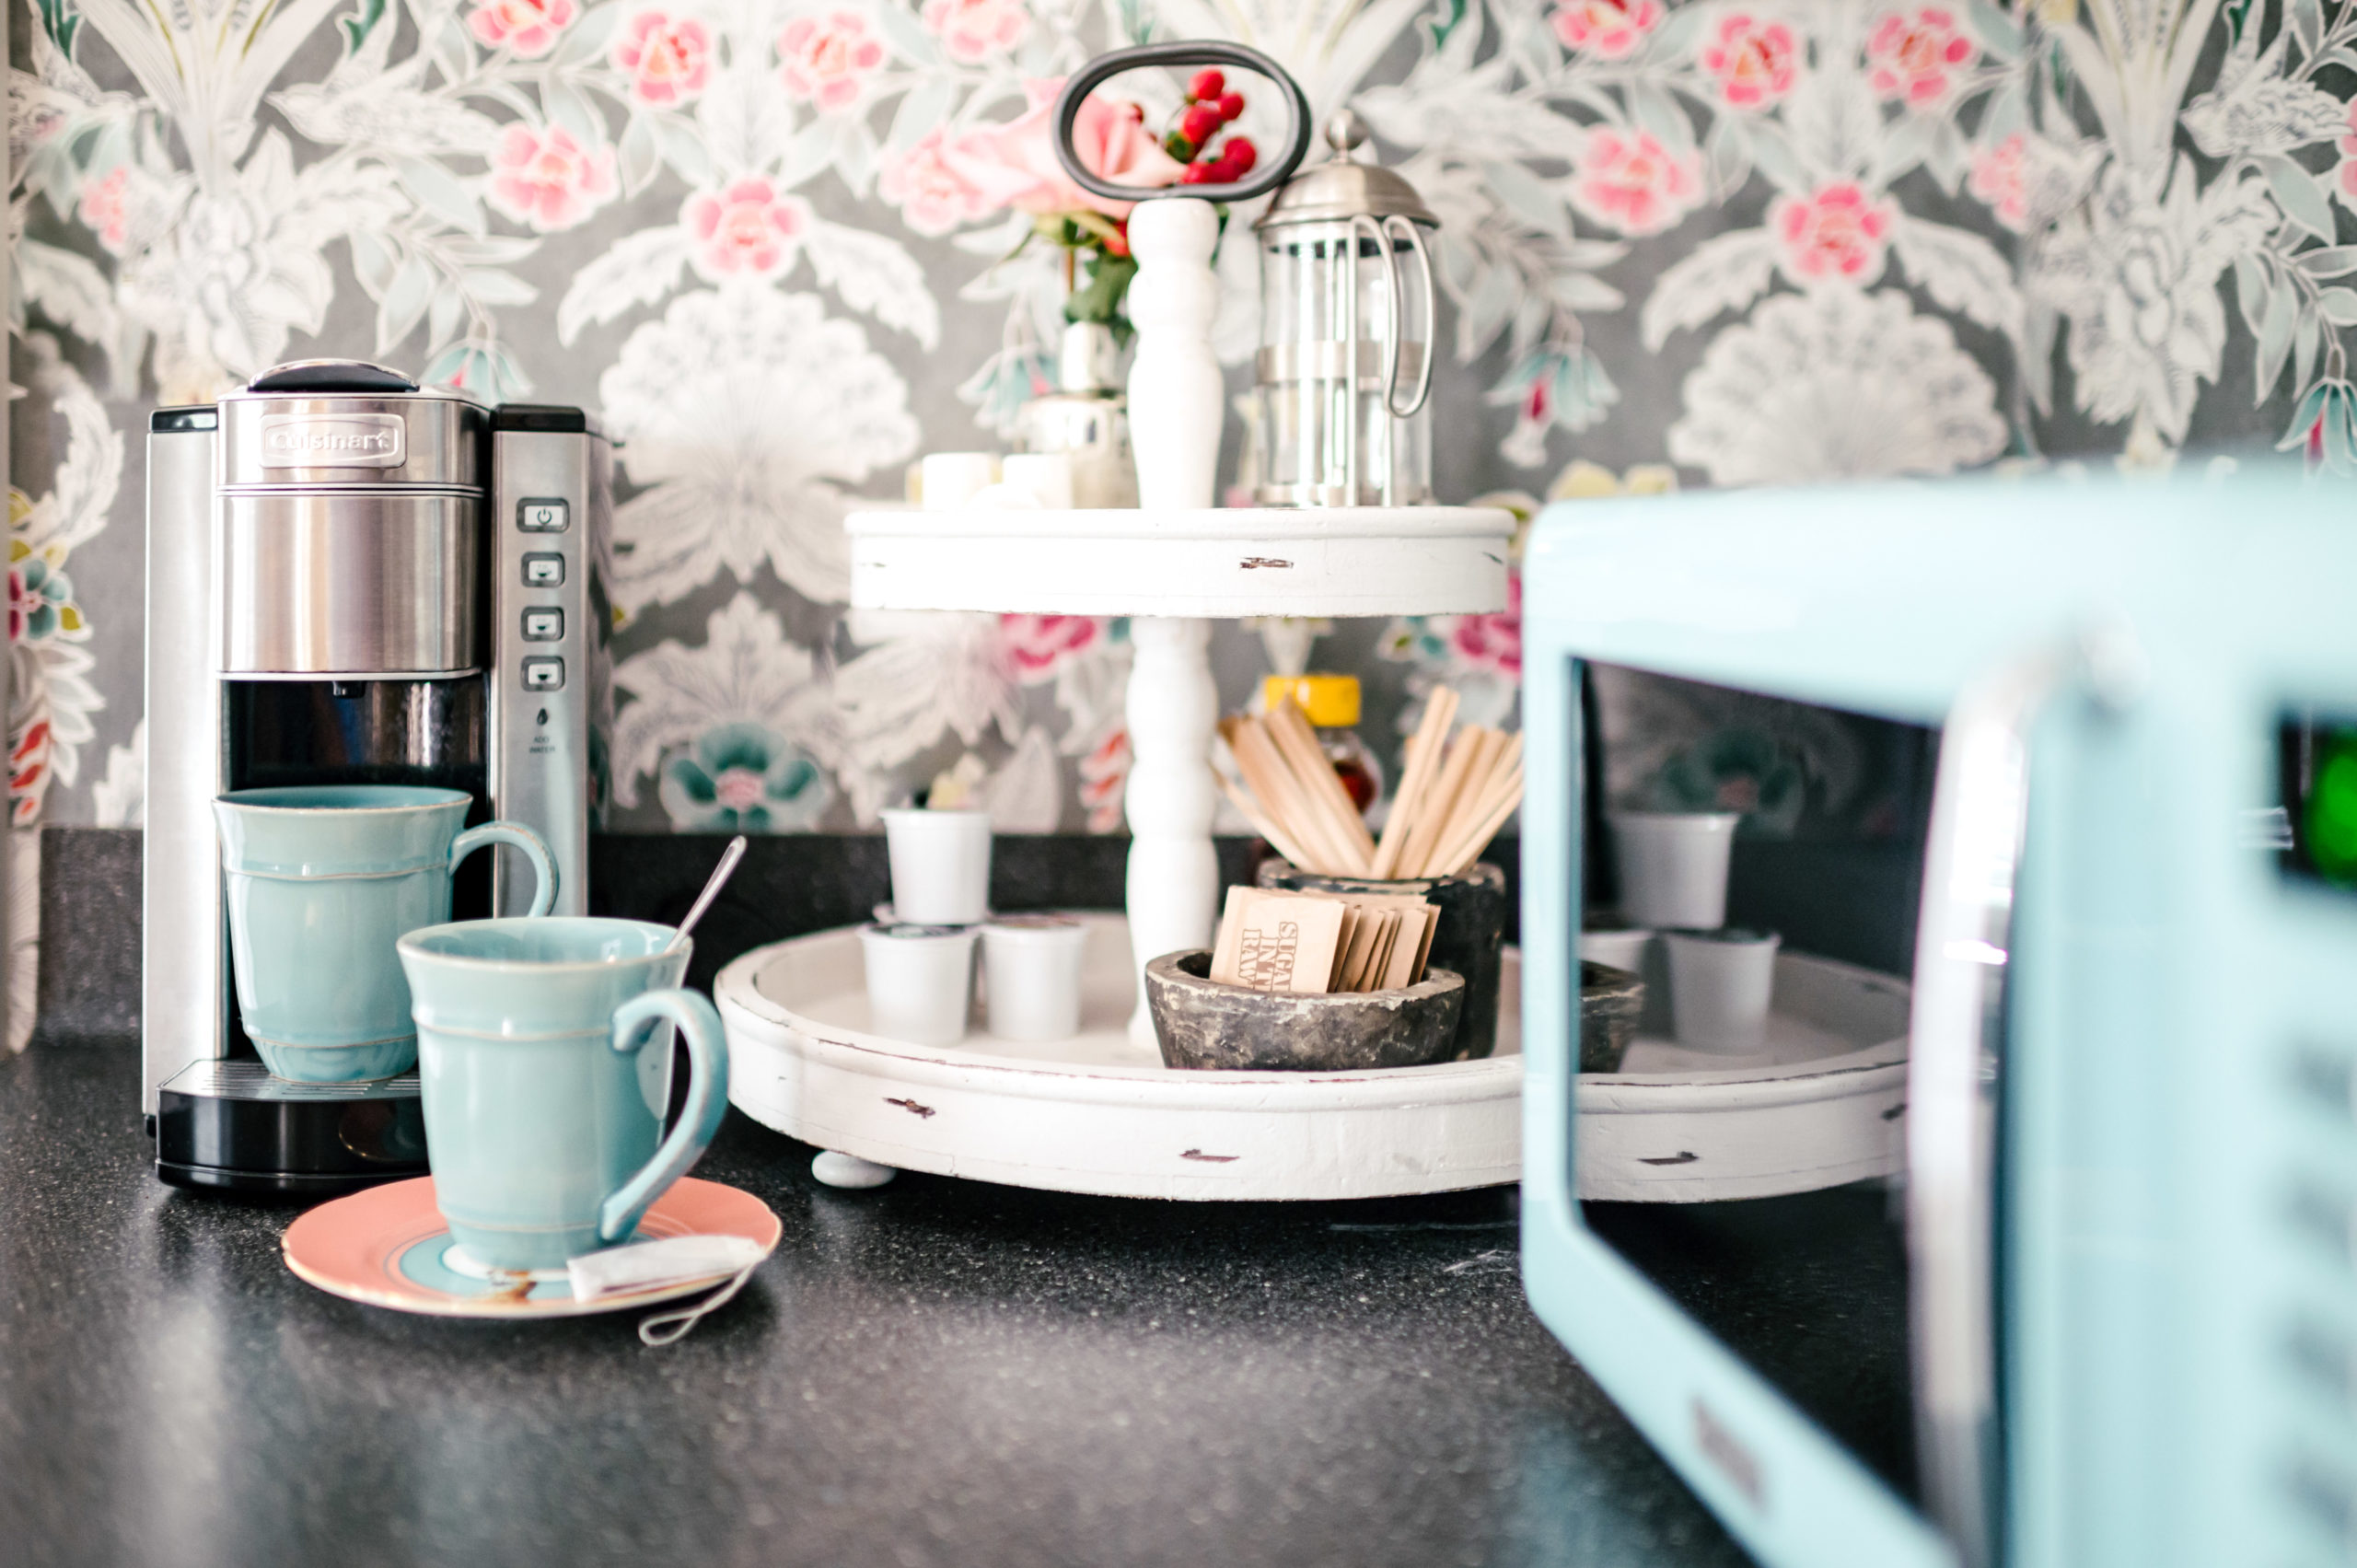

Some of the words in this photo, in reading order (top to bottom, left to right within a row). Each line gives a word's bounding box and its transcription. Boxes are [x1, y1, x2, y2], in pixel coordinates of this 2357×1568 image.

[271, 431, 390, 450] Cuisinart
[1238, 929, 1261, 988] RAW
[1258, 937, 1279, 964] IN
